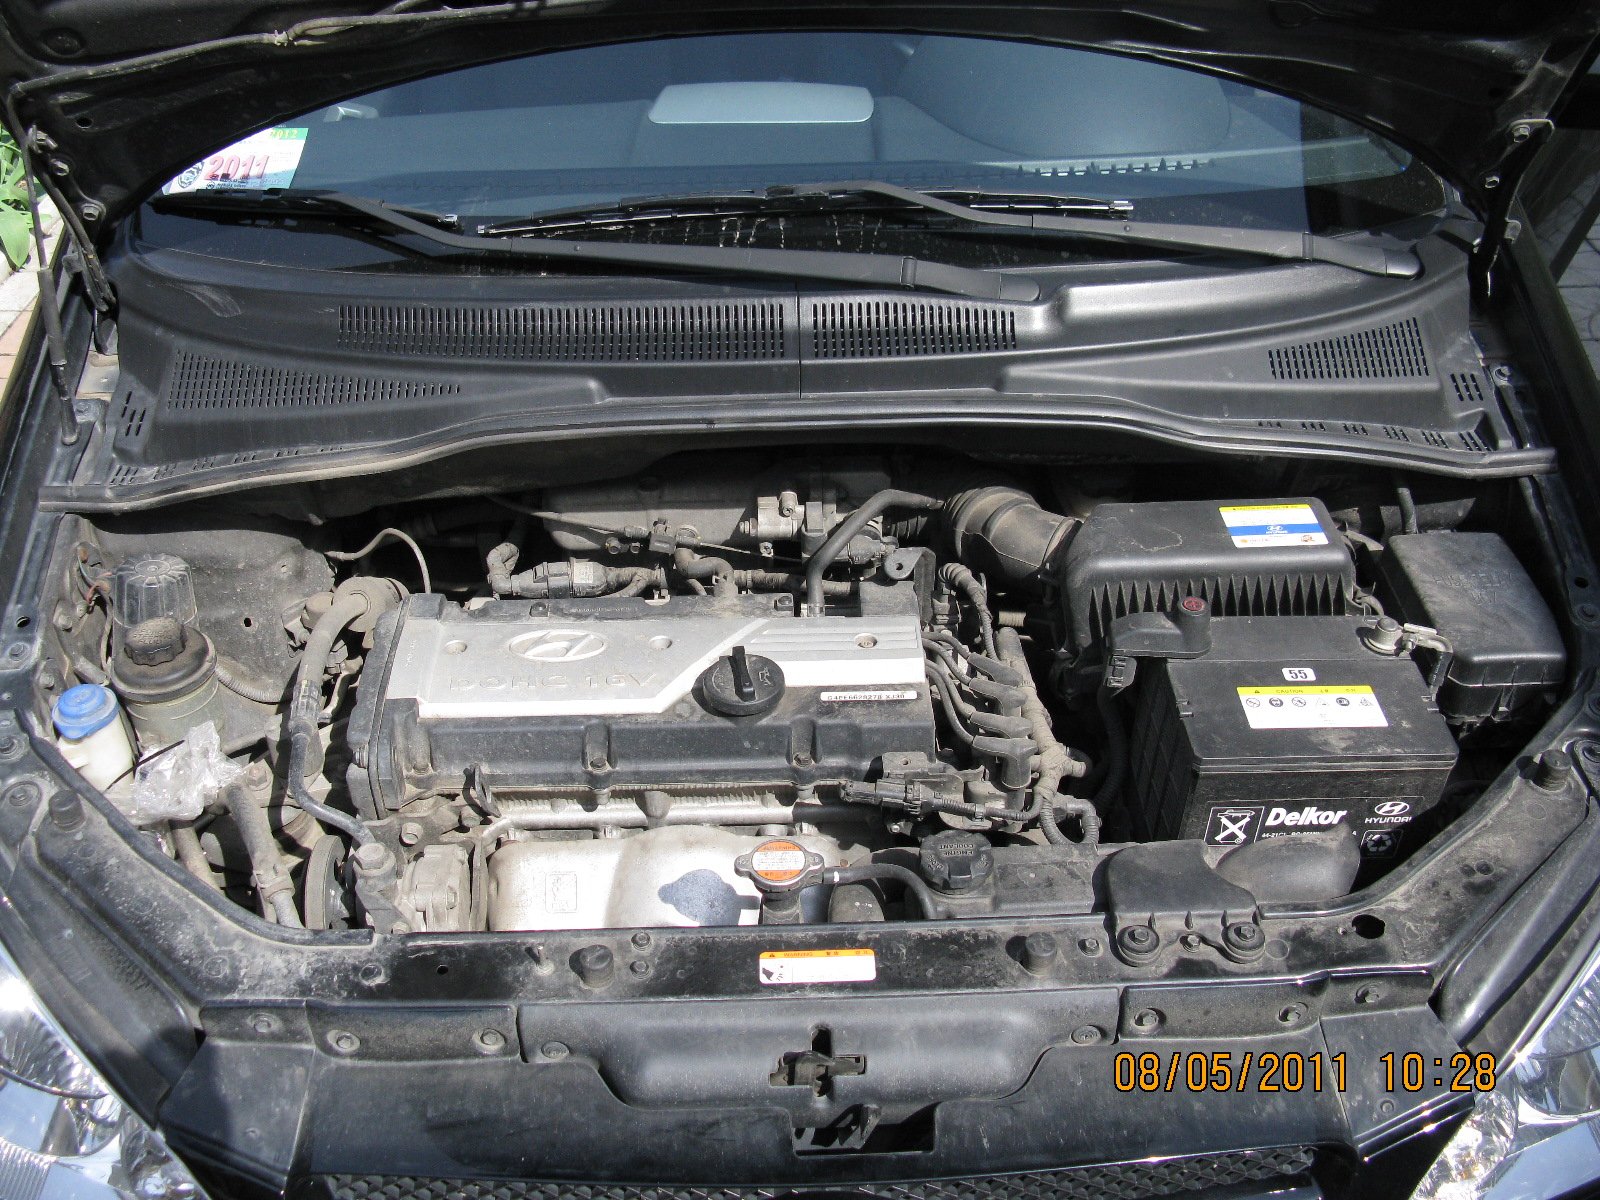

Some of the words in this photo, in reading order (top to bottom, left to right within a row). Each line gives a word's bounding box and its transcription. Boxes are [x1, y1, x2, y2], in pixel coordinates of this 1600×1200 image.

[204, 154, 269, 180] 2011
[449, 675, 567, 690] DOHC
[585, 673, 656, 687] 16V
[1288, 669, 1308, 680] 55
[1265, 806, 1347, 826] Delkor
[1364, 816, 1412, 824] HYUNDAI
